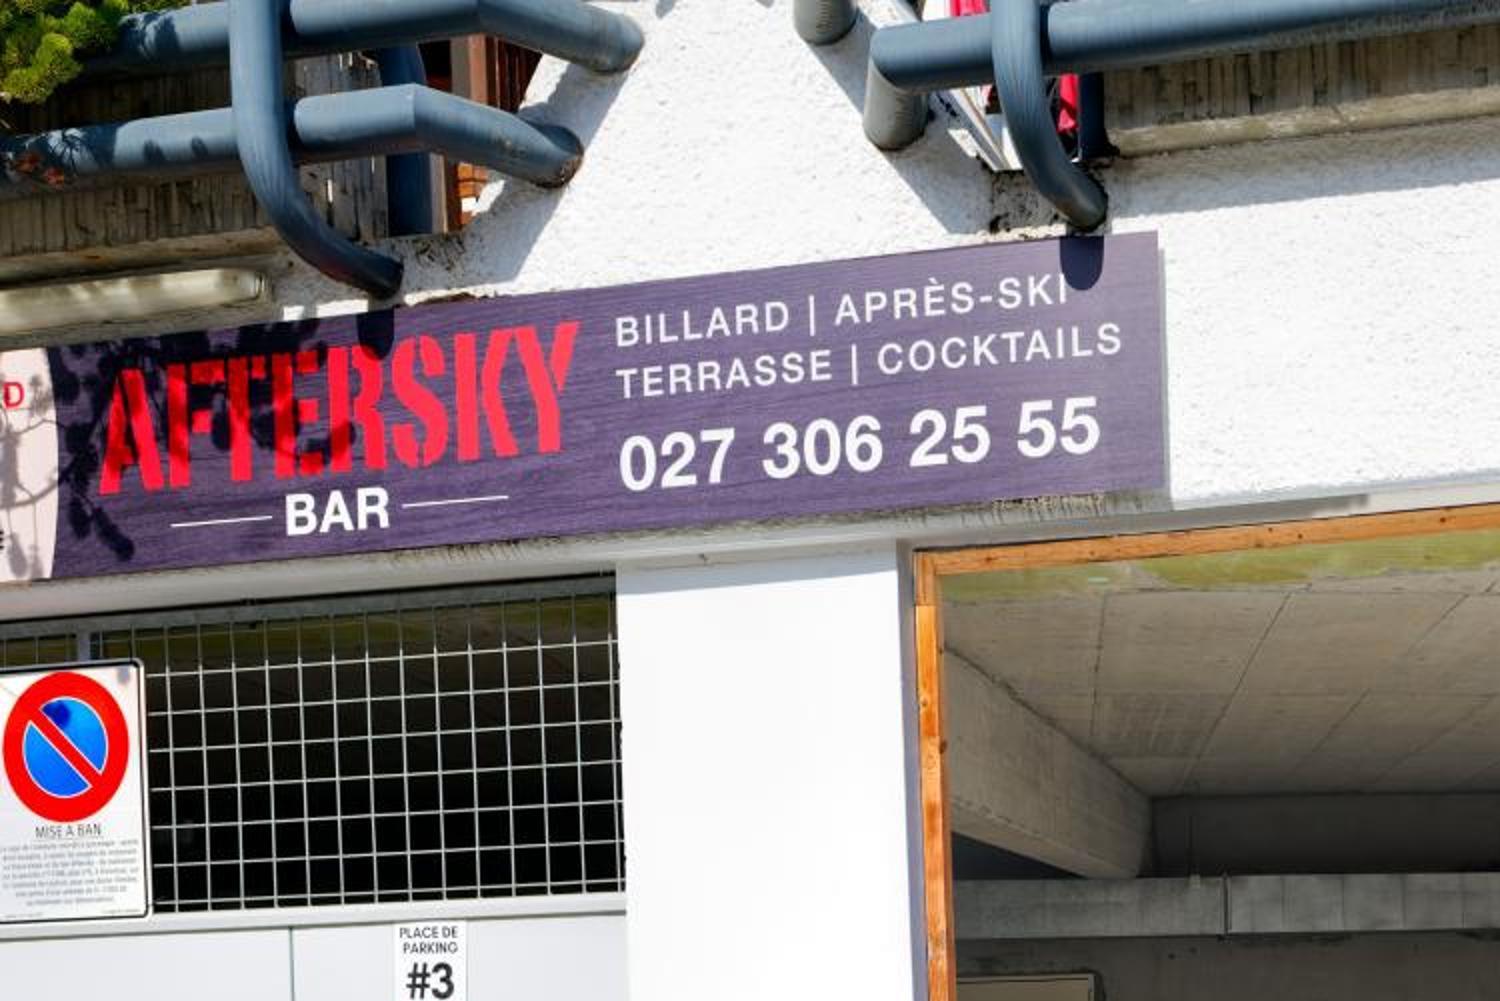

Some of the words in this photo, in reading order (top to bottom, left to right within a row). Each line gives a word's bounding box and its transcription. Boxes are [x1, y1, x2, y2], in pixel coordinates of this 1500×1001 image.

[616, 301, 790, 347] BILLARD
[835, 276, 1067, 325] APRÈS-SKI
[616, 350, 832, 399] TERRASSE
[878, 323, 1121, 375] COCKTAILS
[100, 321, 580, 494] AFTERSKY
[619, 428, 735, 491] 027
[762, 415, 883, 479] 306
[909, 406, 991, 467] 25
[1017, 397, 1100, 457] 55
[285, 487, 389, 536] BAR
[35, 826, 62, 839] MISE
[78, 823, 101, 836] BAN
[399, 926, 439, 939] PLACE
[442, 925, 458, 939] DE
[403, 941, 459, 954] PARKING
[406, 961, 455, 1000] #3
